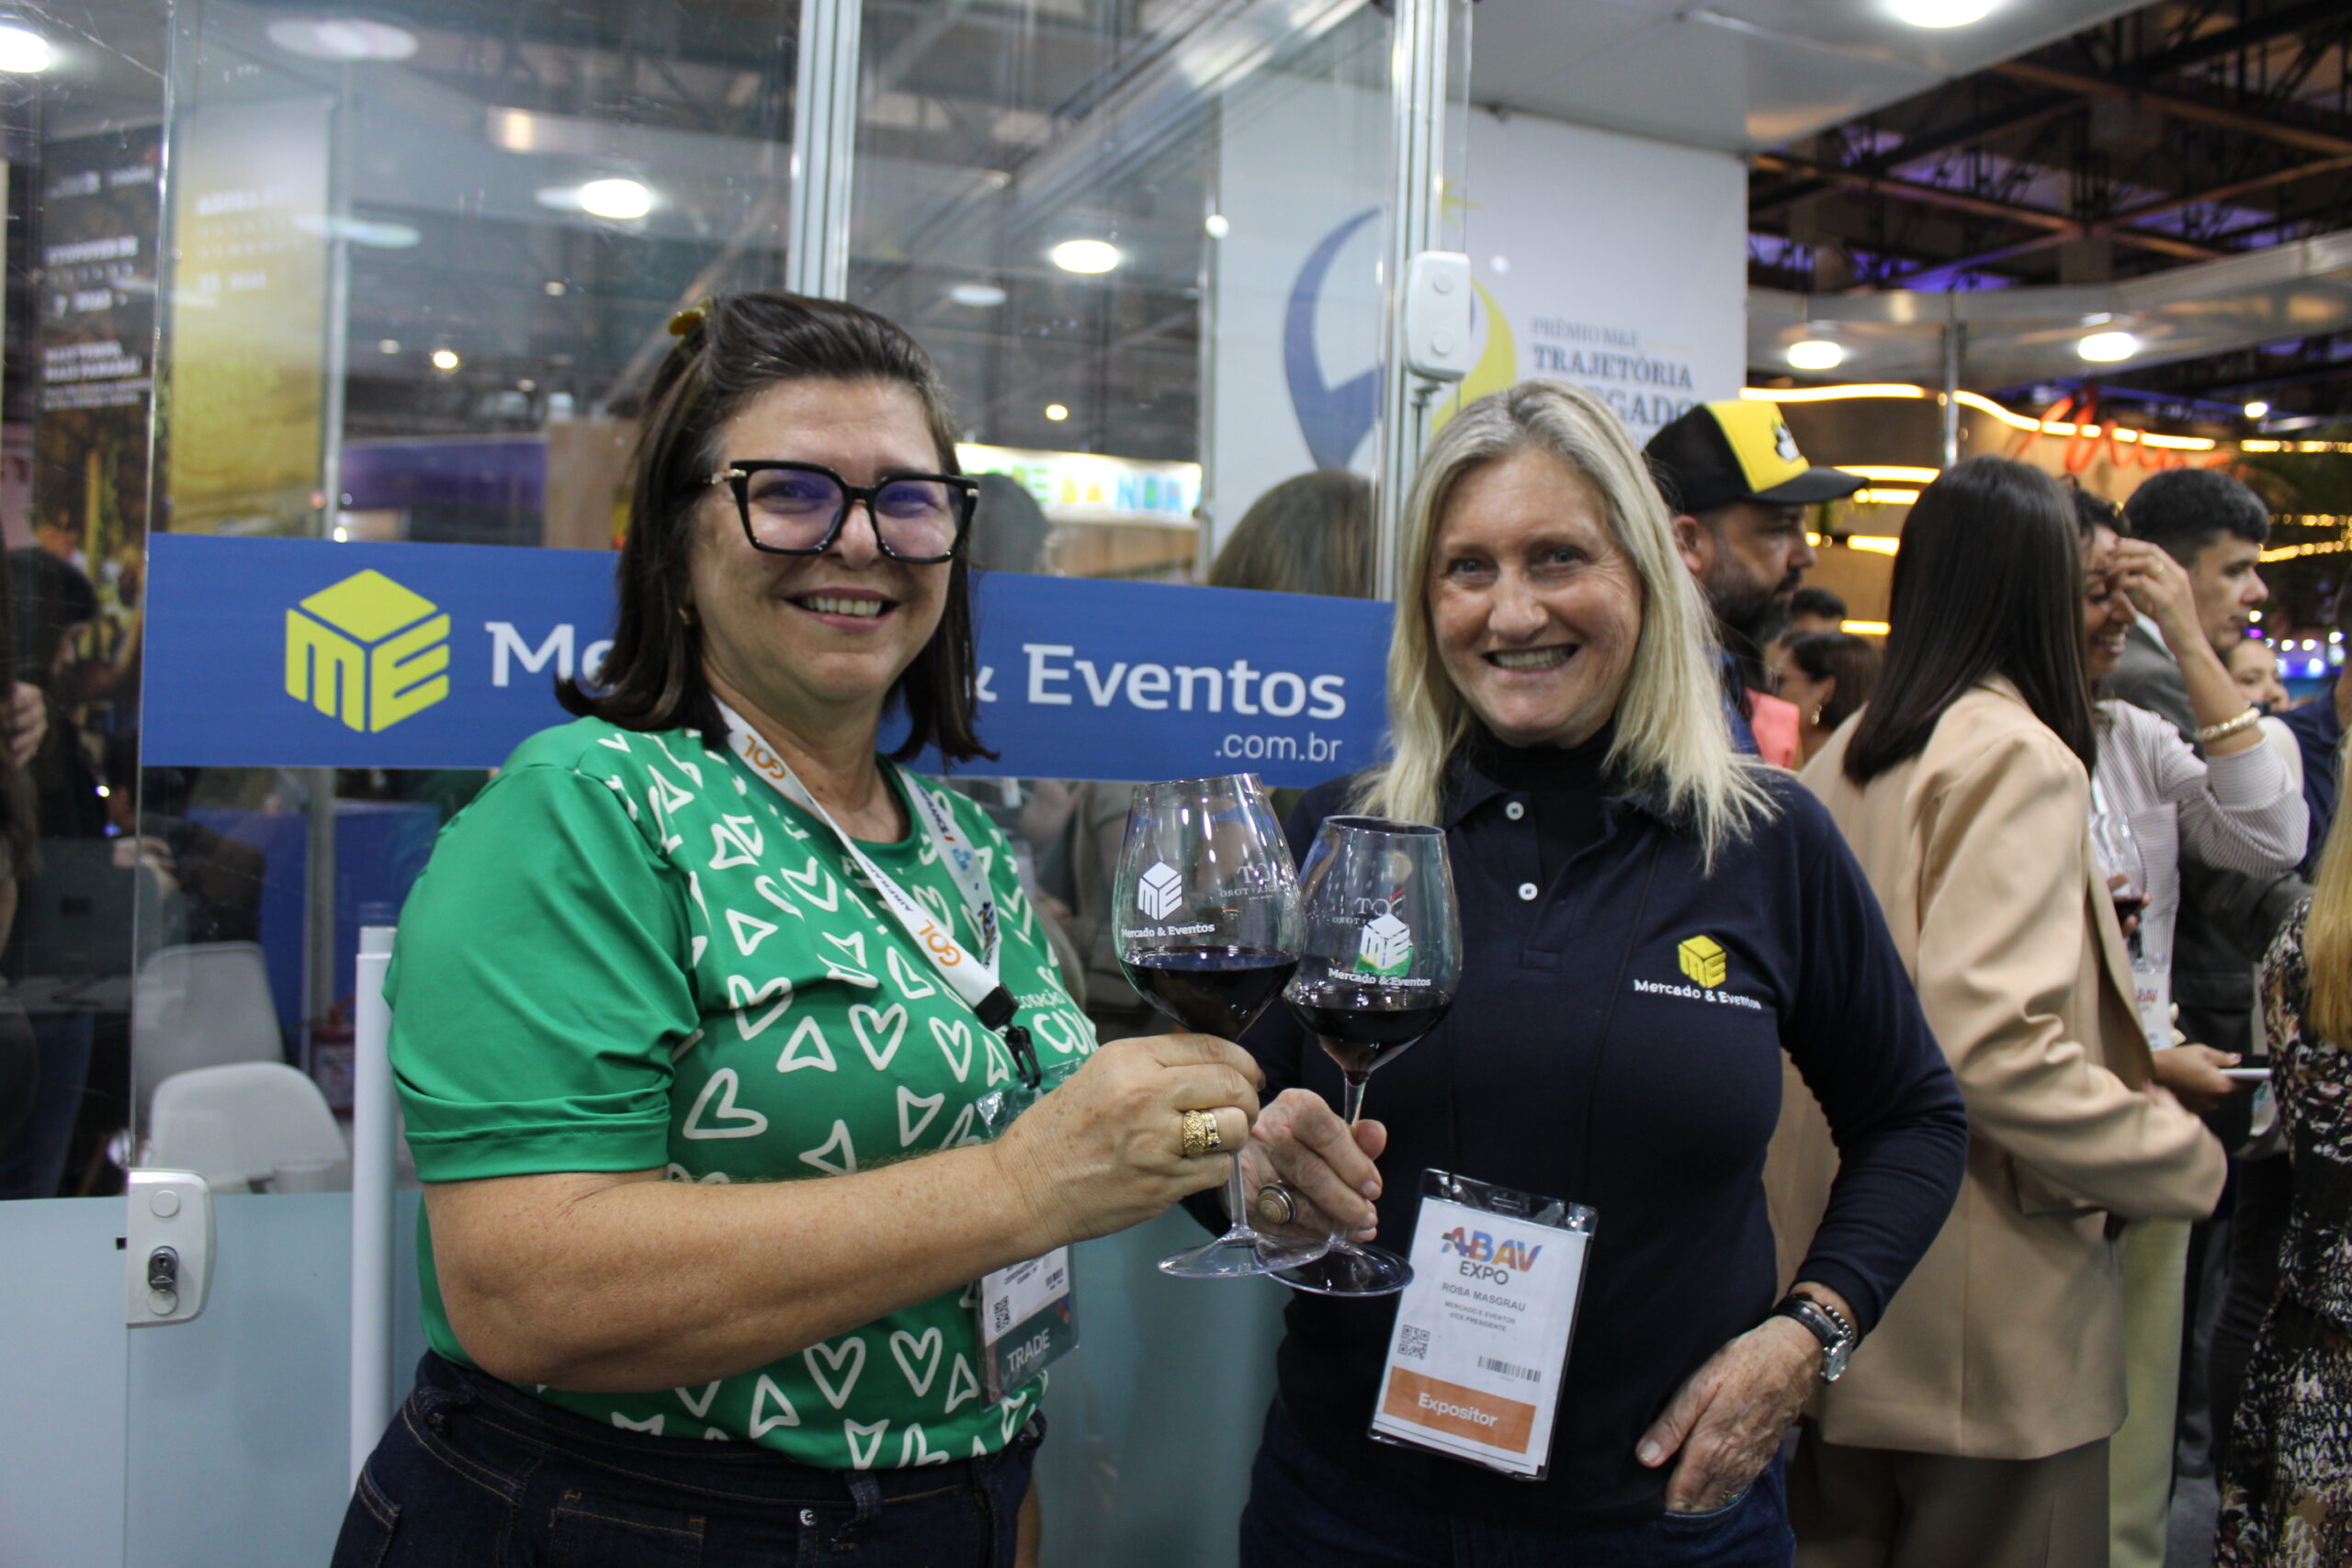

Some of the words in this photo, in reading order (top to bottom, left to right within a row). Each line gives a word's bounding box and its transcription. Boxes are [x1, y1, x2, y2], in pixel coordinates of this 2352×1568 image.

[1533, 344, 1692, 390] TRAJETÓRIA
[1023, 643, 1347, 720] Eventos
[743, 734, 786, 779] GOL
[1214, 732, 1343, 762] .com.br
[918, 919, 962, 966] GOL
[1121, 927, 1155, 939] Mercado
[1157, 926, 1167, 936] &
[1168, 923, 1216, 937] Eventos
[1329, 967, 1377, 985] Mercado
[1379, 976, 1389, 986] &
[1389, 976, 1432, 987] Eventos
[1634, 978, 1702, 999] Mercado
[1704, 990, 1716, 1002] &
[1441, 1226, 1544, 1273] ABAV
[1459, 1260, 1510, 1286] EXPO
[1442, 1282, 1471, 1298] ROSA
[1473, 1291, 1527, 1313] MASGRAU
[1007, 1328, 1051, 1372] TRADE
[1418, 1392, 1498, 1427] Expositor
